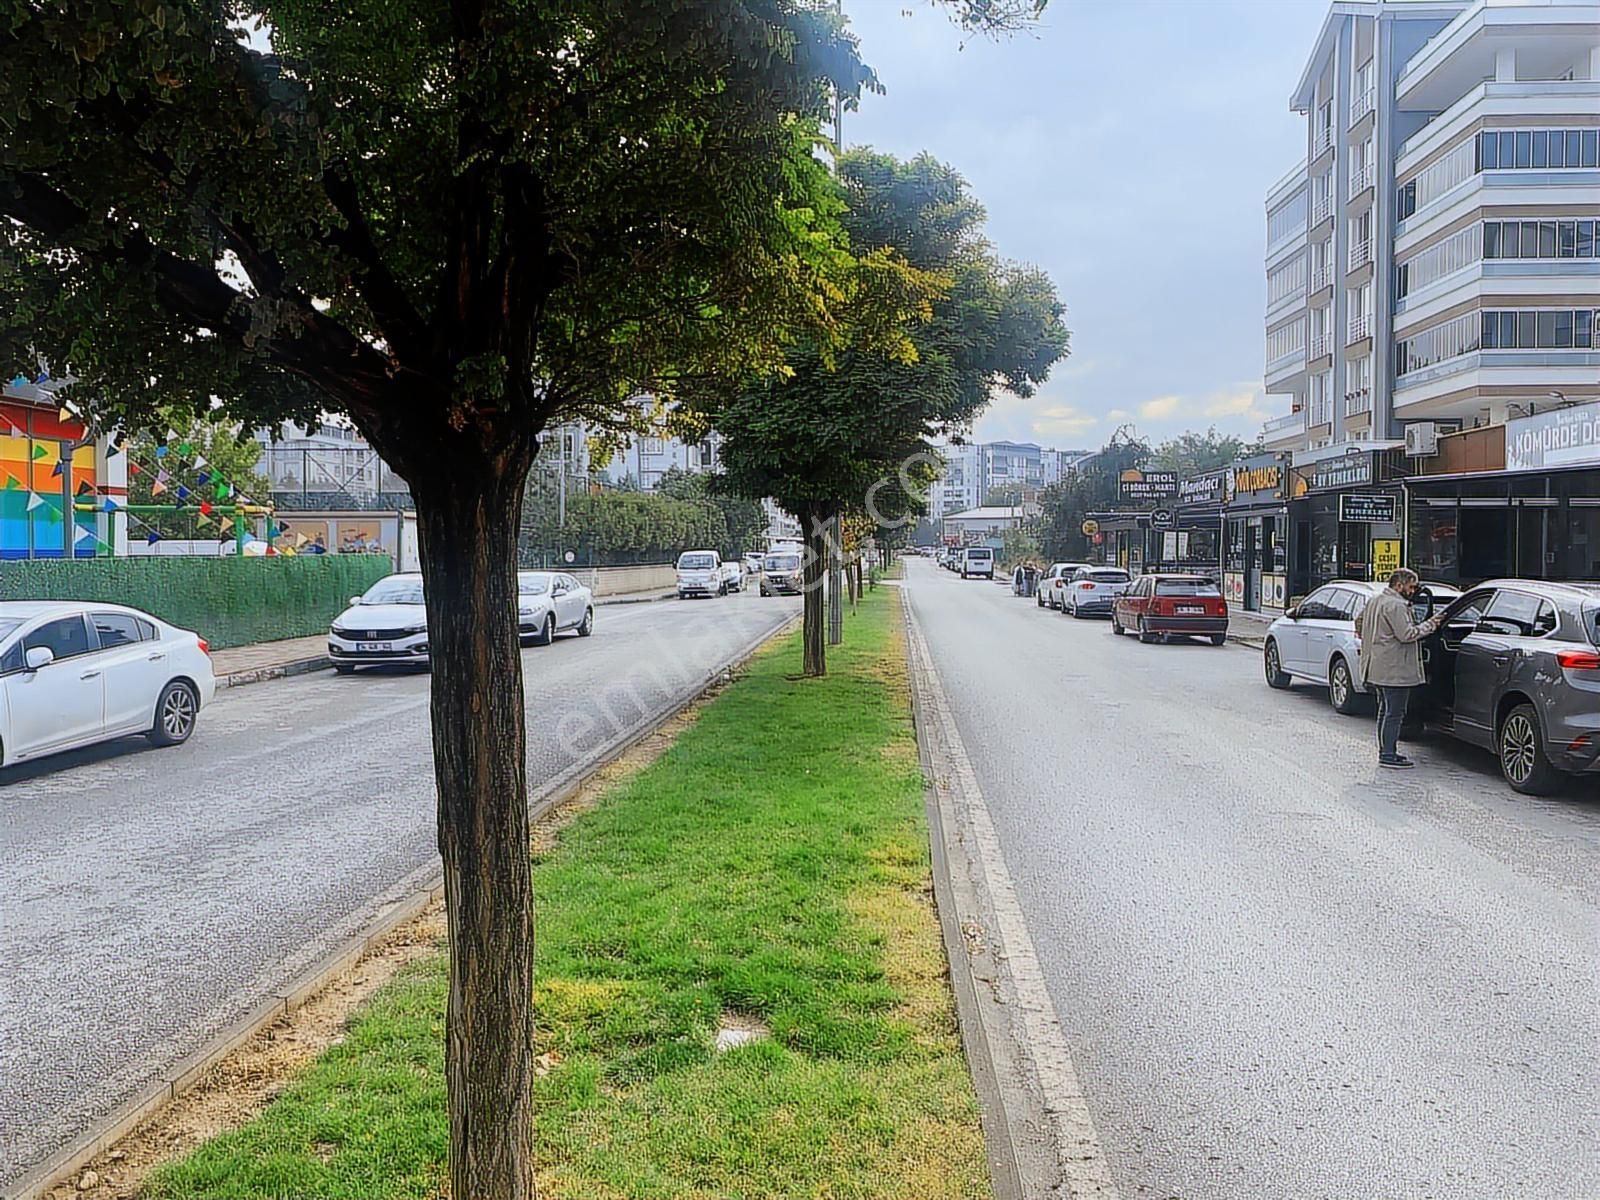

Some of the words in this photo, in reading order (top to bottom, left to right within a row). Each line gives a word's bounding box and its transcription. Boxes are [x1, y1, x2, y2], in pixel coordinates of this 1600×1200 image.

[1515, 424, 1577, 456] KÖMÜRDE
[1146, 474, 1175, 483] EROL
[1385, 542, 1391, 553] 3
